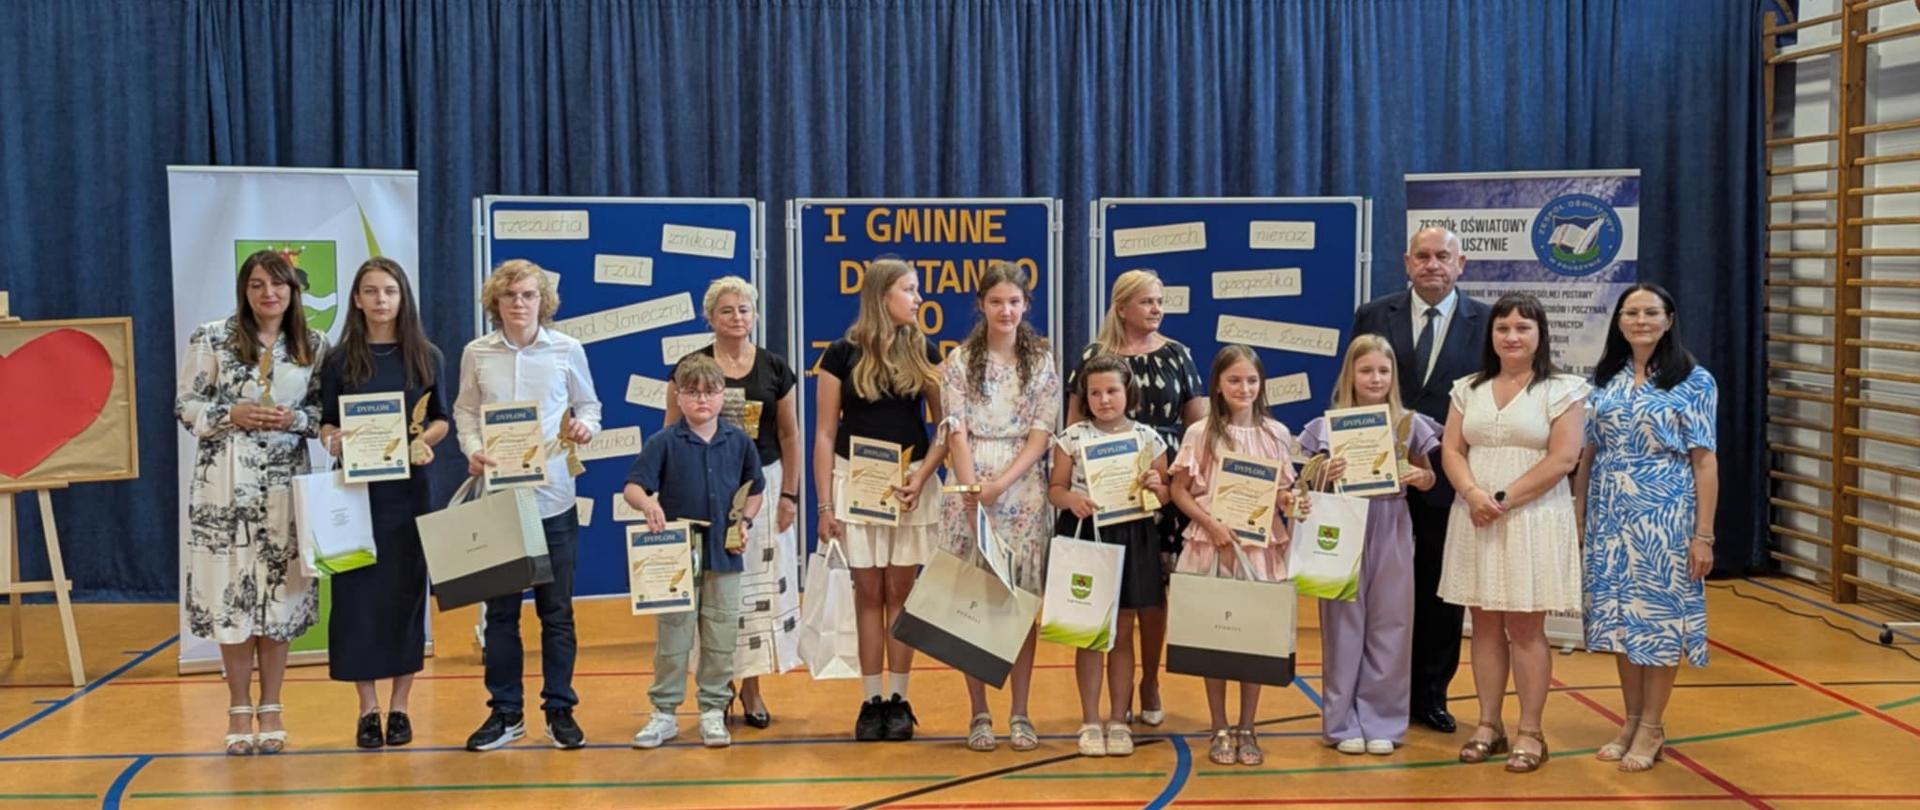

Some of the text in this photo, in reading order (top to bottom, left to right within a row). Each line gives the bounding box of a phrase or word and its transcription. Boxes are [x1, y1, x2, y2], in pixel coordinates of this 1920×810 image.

[824, 208, 1006, 243] I GMINNE
[1460, 216, 1527, 233] OŚWIATOWY
[1120, 228, 1199, 250] zmierzch
[1255, 229, 1307, 243] nieraz
[1461, 238, 1508, 252] USZYNIE
[918, 301, 943, 335] O
[356, 403, 389, 412] DYPLOM
[1343, 417, 1375, 428] DYPLOM
[1233, 463, 1265, 477] DYPLOM
[644, 532, 676, 543] DYPLOM
